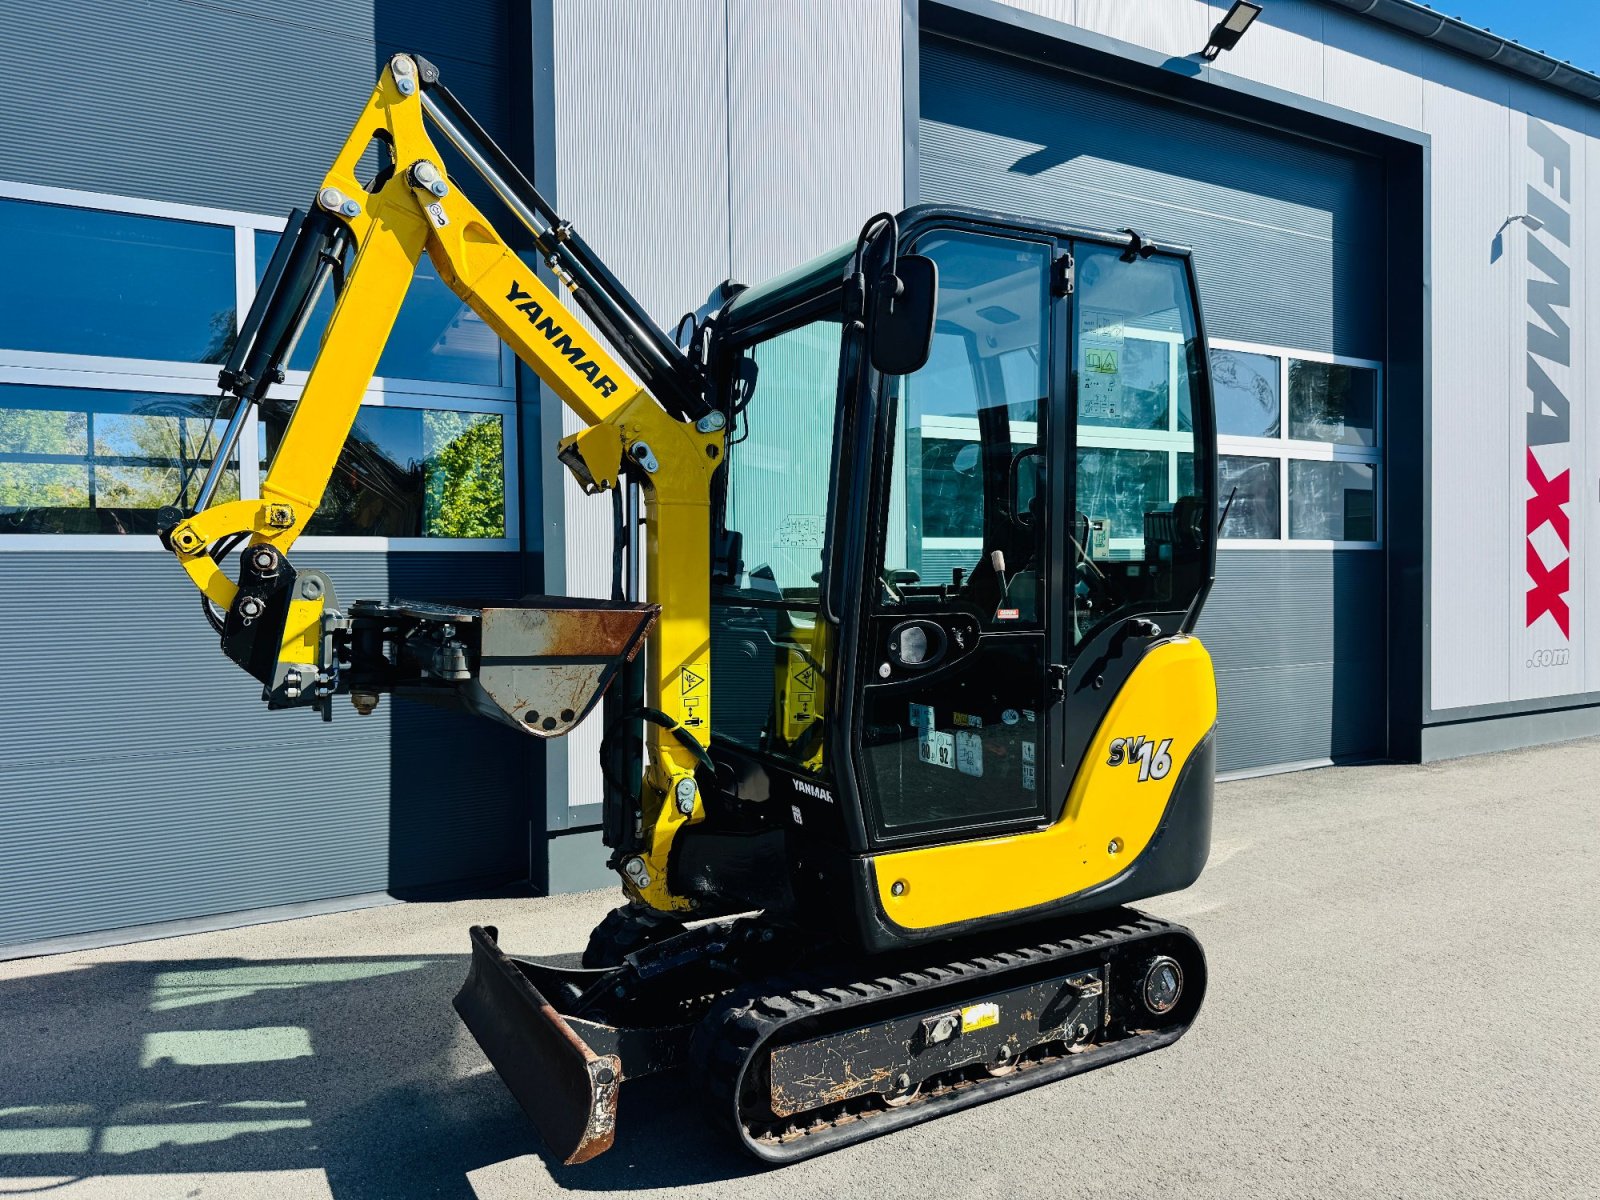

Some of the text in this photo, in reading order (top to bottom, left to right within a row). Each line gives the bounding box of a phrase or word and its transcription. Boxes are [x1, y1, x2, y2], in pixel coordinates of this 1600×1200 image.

[505, 279, 619, 399] YANMAR
[1526, 111, 1570, 642] FIMAXX
[1525, 648, 1570, 669] .com
[792, 778, 834, 804] YANMAR
